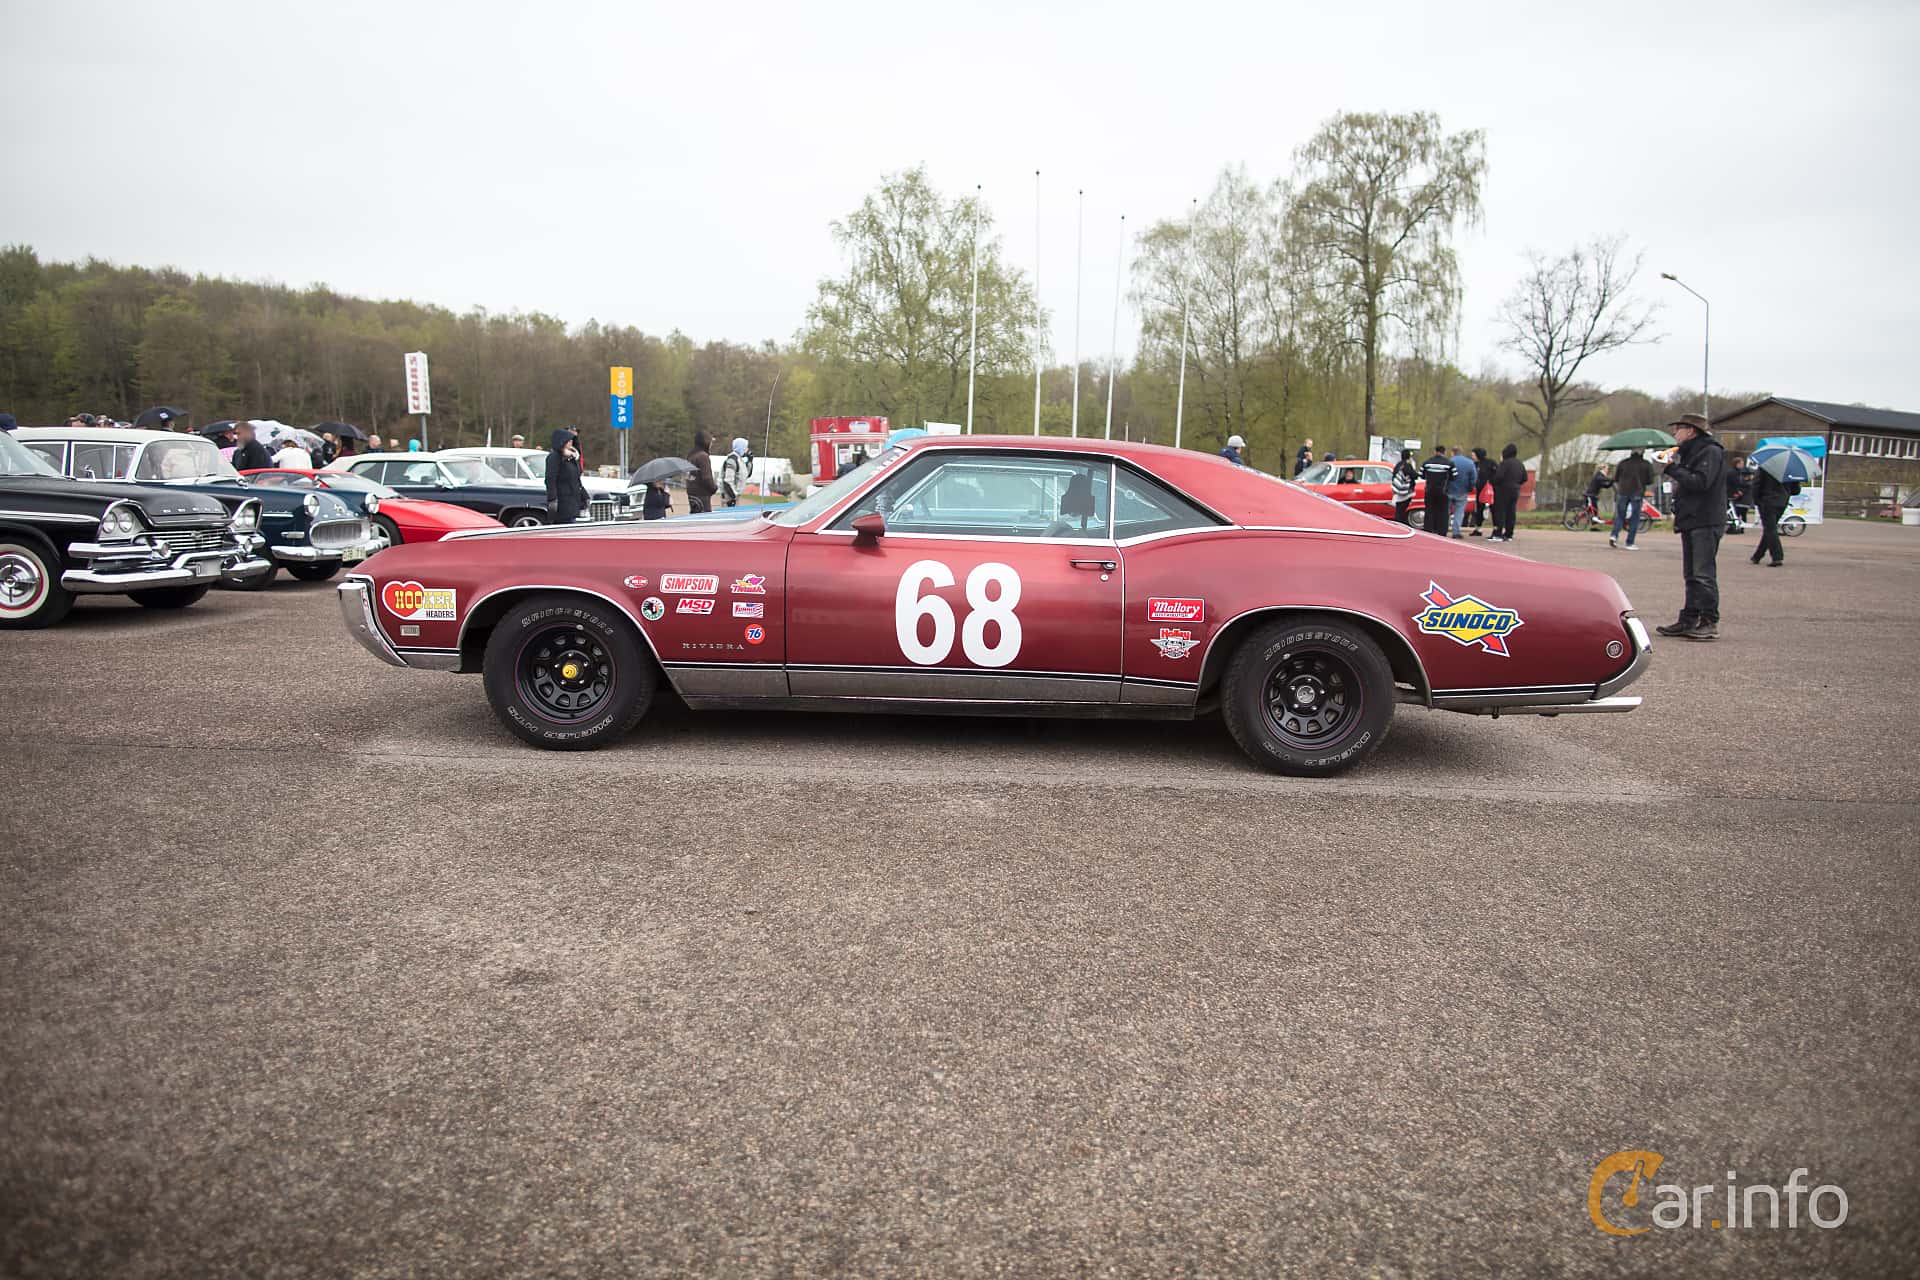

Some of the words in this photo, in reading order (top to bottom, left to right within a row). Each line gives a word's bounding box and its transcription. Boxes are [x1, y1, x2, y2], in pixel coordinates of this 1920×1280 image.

[617, 371, 627, 423] SWECON
[665, 577, 714, 590] SIMPSON
[394, 590, 455, 609] HOOKER
[679, 600, 713, 609] MSD
[426, 610, 456, 618] HEADERS
[896, 560, 1022, 667] 68
[1153, 601, 1200, 618] Mallory
[1425, 612, 1512, 630] SUNOCO
[749, 627, 762, 639] 76
